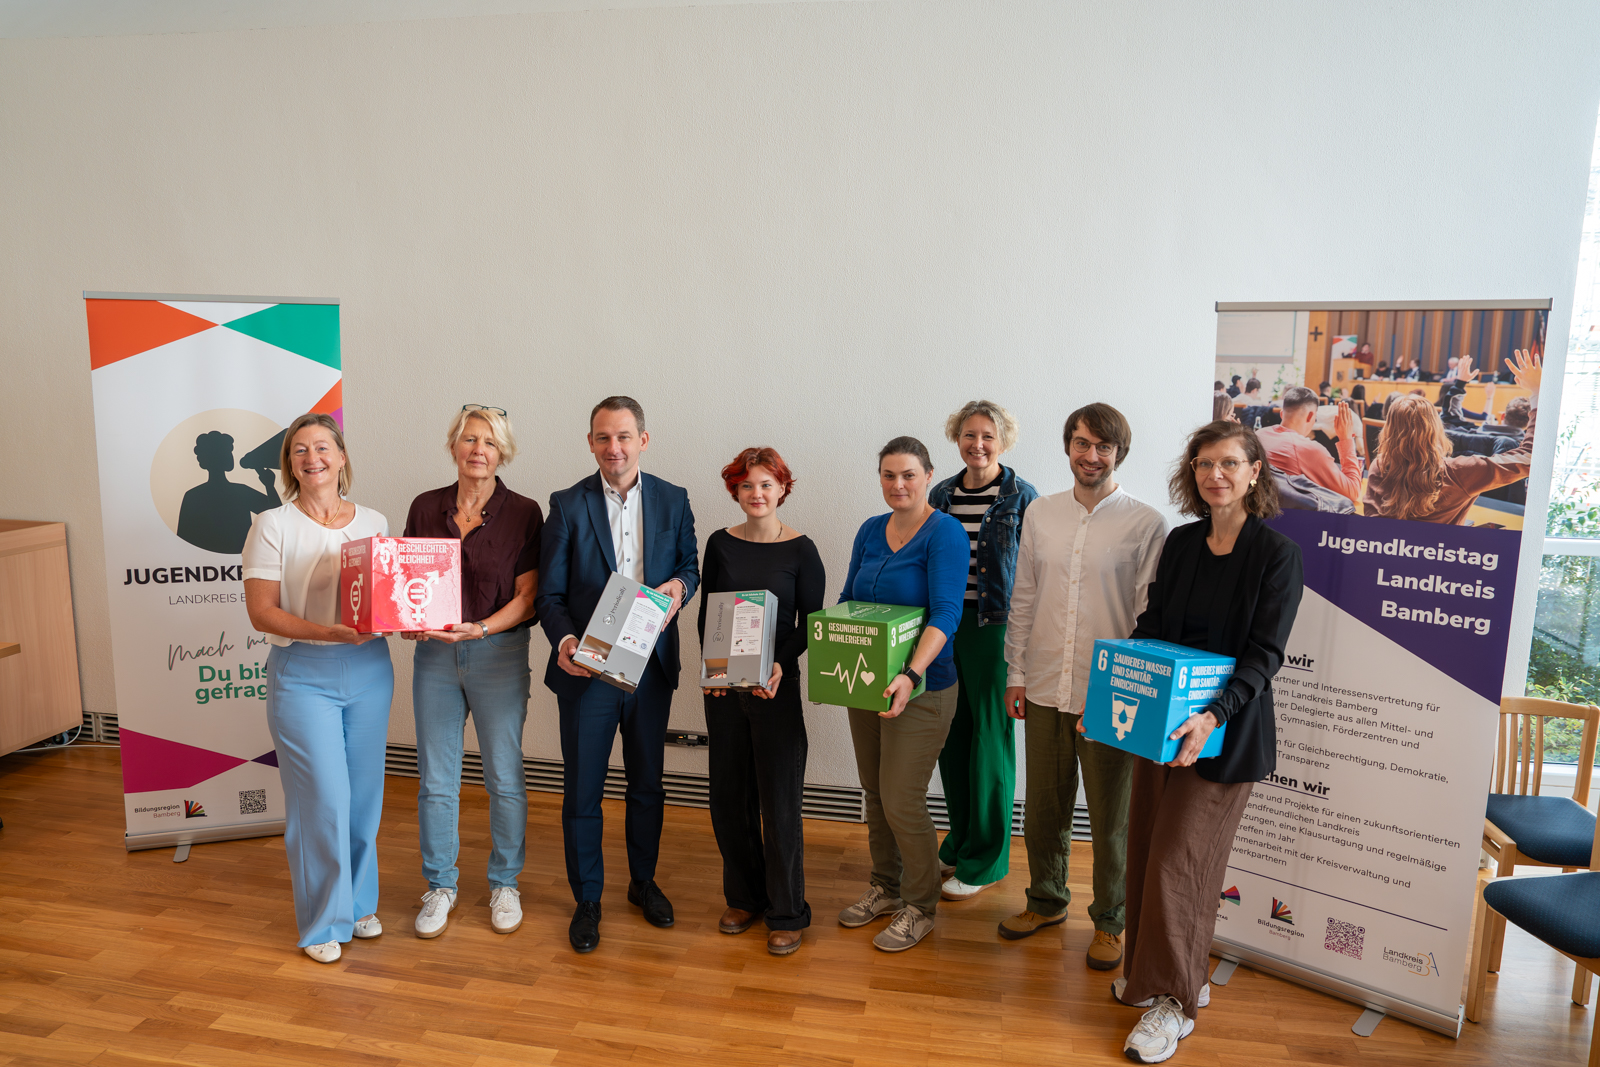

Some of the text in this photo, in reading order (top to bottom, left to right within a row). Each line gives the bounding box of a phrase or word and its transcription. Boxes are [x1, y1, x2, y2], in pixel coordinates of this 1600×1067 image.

[380, 544, 390, 564] 5
[398, 544, 449, 554] GESCHLECHTER-
[1318, 530, 1498, 570] Jugendkreistag
[398, 555, 434, 564] GLEICHHEIT
[1377, 568, 1495, 600] Landkreis
[169, 593, 237, 605] LANDKREIS
[1381, 600, 1490, 636] Bamberg
[814, 621, 822, 640] 3
[828, 622, 878, 636] GESUNDHEIT UND
[891, 627, 896, 648] 3
[828, 633, 872, 646] WOHLERGEHEN
[168, 631, 234, 670] Mach
[1098, 650, 1108, 671] 6
[1114, 652, 1172, 677] SAUBERES WASSER
[1192, 666, 1215, 676] SAUBERES
[1287, 654, 1314, 668] wir
[199, 665, 231, 682] Du
[1112, 665, 1153, 684] UND SANITÄR-
[1178, 666, 1188, 689] 6
[1110, 676, 1158, 698] EINRICHTUNGEN
[1302, 681, 1318, 690] und
[1321, 683, 1423, 711] Interessensvertretung
[1426, 703, 1440, 713] für
[1278, 688, 1288, 696] im
[1291, 690, 1333, 706] Landkreis
[1336, 699, 1378, 716] Bamberg
[1290, 702, 1334, 720] Delegierte
[1337, 714, 1353, 723] aus
[1356, 716, 1378, 728] allen
[1380, 720, 1412, 735] Mittel-
[1414, 728, 1434, 739] und
[1280, 714, 1420, 750] Gymnasien, Förderzentren und
[1276, 750, 1330, 770] Transparenz
[1284, 739, 1449, 784] für Gleichberechtigung, Demokratie,
[1265, 772, 1330, 795] hen wir
[134, 804, 180, 814] Bildungsregion
[153, 810, 180, 818] Bamberg
[1246, 802, 1360, 836] endfreundlichen Landkreis
[1266, 795, 1282, 804] und
[1285, 798, 1319, 813] Projekte
[1322, 808, 1334, 816] für
[1336, 812, 1361, 824] einen
[1364, 818, 1460, 849] zukunftsorientierten
[1266, 830, 1276, 838] im
[1278, 834, 1296, 844] Jahr
[1279, 822, 1296, 832] eine
[1299, 827, 1364, 851] Klausurtagung
[1366, 845, 1384, 855] und
[1386, 850, 1446, 872] regelmäßige
[1284, 848, 1298, 858] mit
[1300, 852, 1314, 861] der
[1316, 856, 1390, 884] Kreisverwaltung
[1392, 878, 1410, 888] und
[1258, 918, 1305, 938] Bildungsregion
[1268, 929, 1291, 941] Bamberg
[1382, 953, 1422, 972] Bamberg
[1384, 946, 1424, 965] Landkreis
